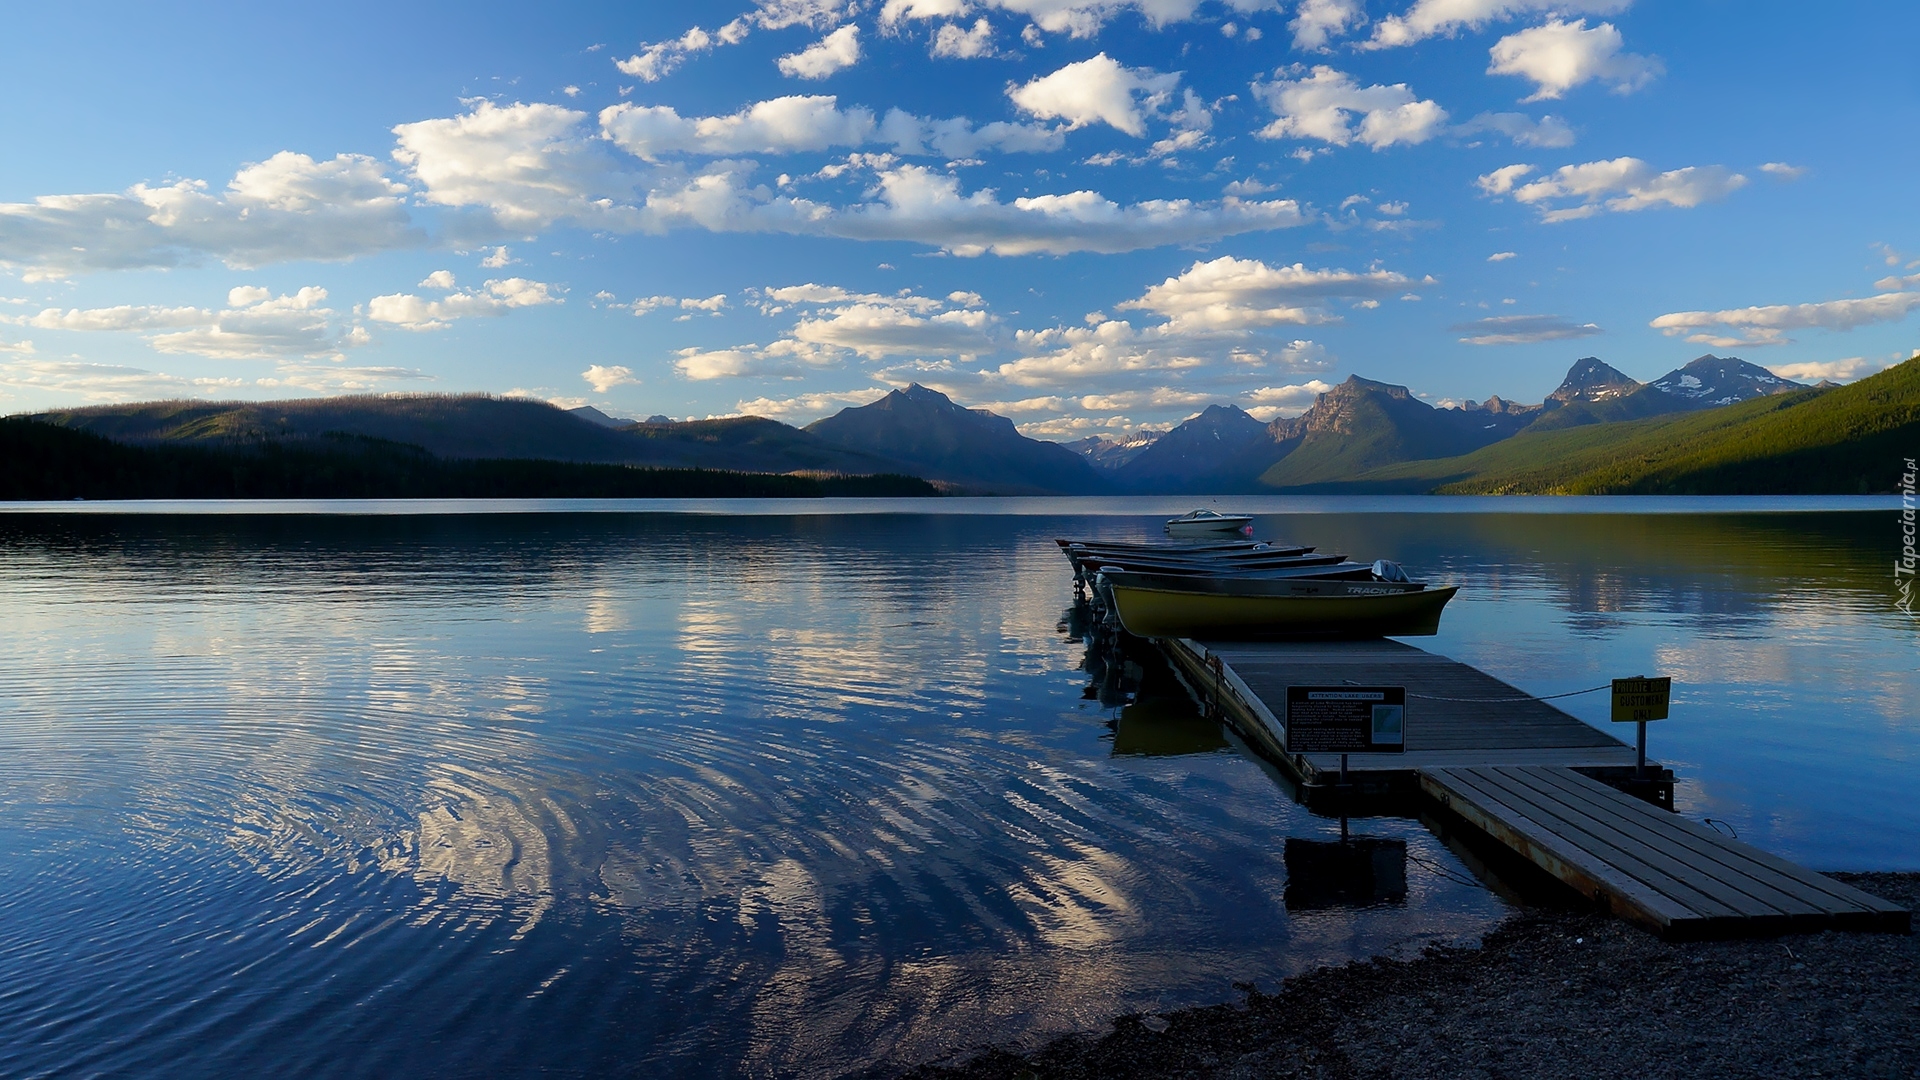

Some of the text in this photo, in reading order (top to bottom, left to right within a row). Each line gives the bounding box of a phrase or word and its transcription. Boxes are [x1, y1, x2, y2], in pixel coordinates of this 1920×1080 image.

[1346, 586, 1405, 595] TRACKER
[1615, 680, 1668, 693] PRIVATE DOCK
[1621, 695, 1663, 706] CUSTOMERS
[1633, 709, 1652, 720] ONLY
